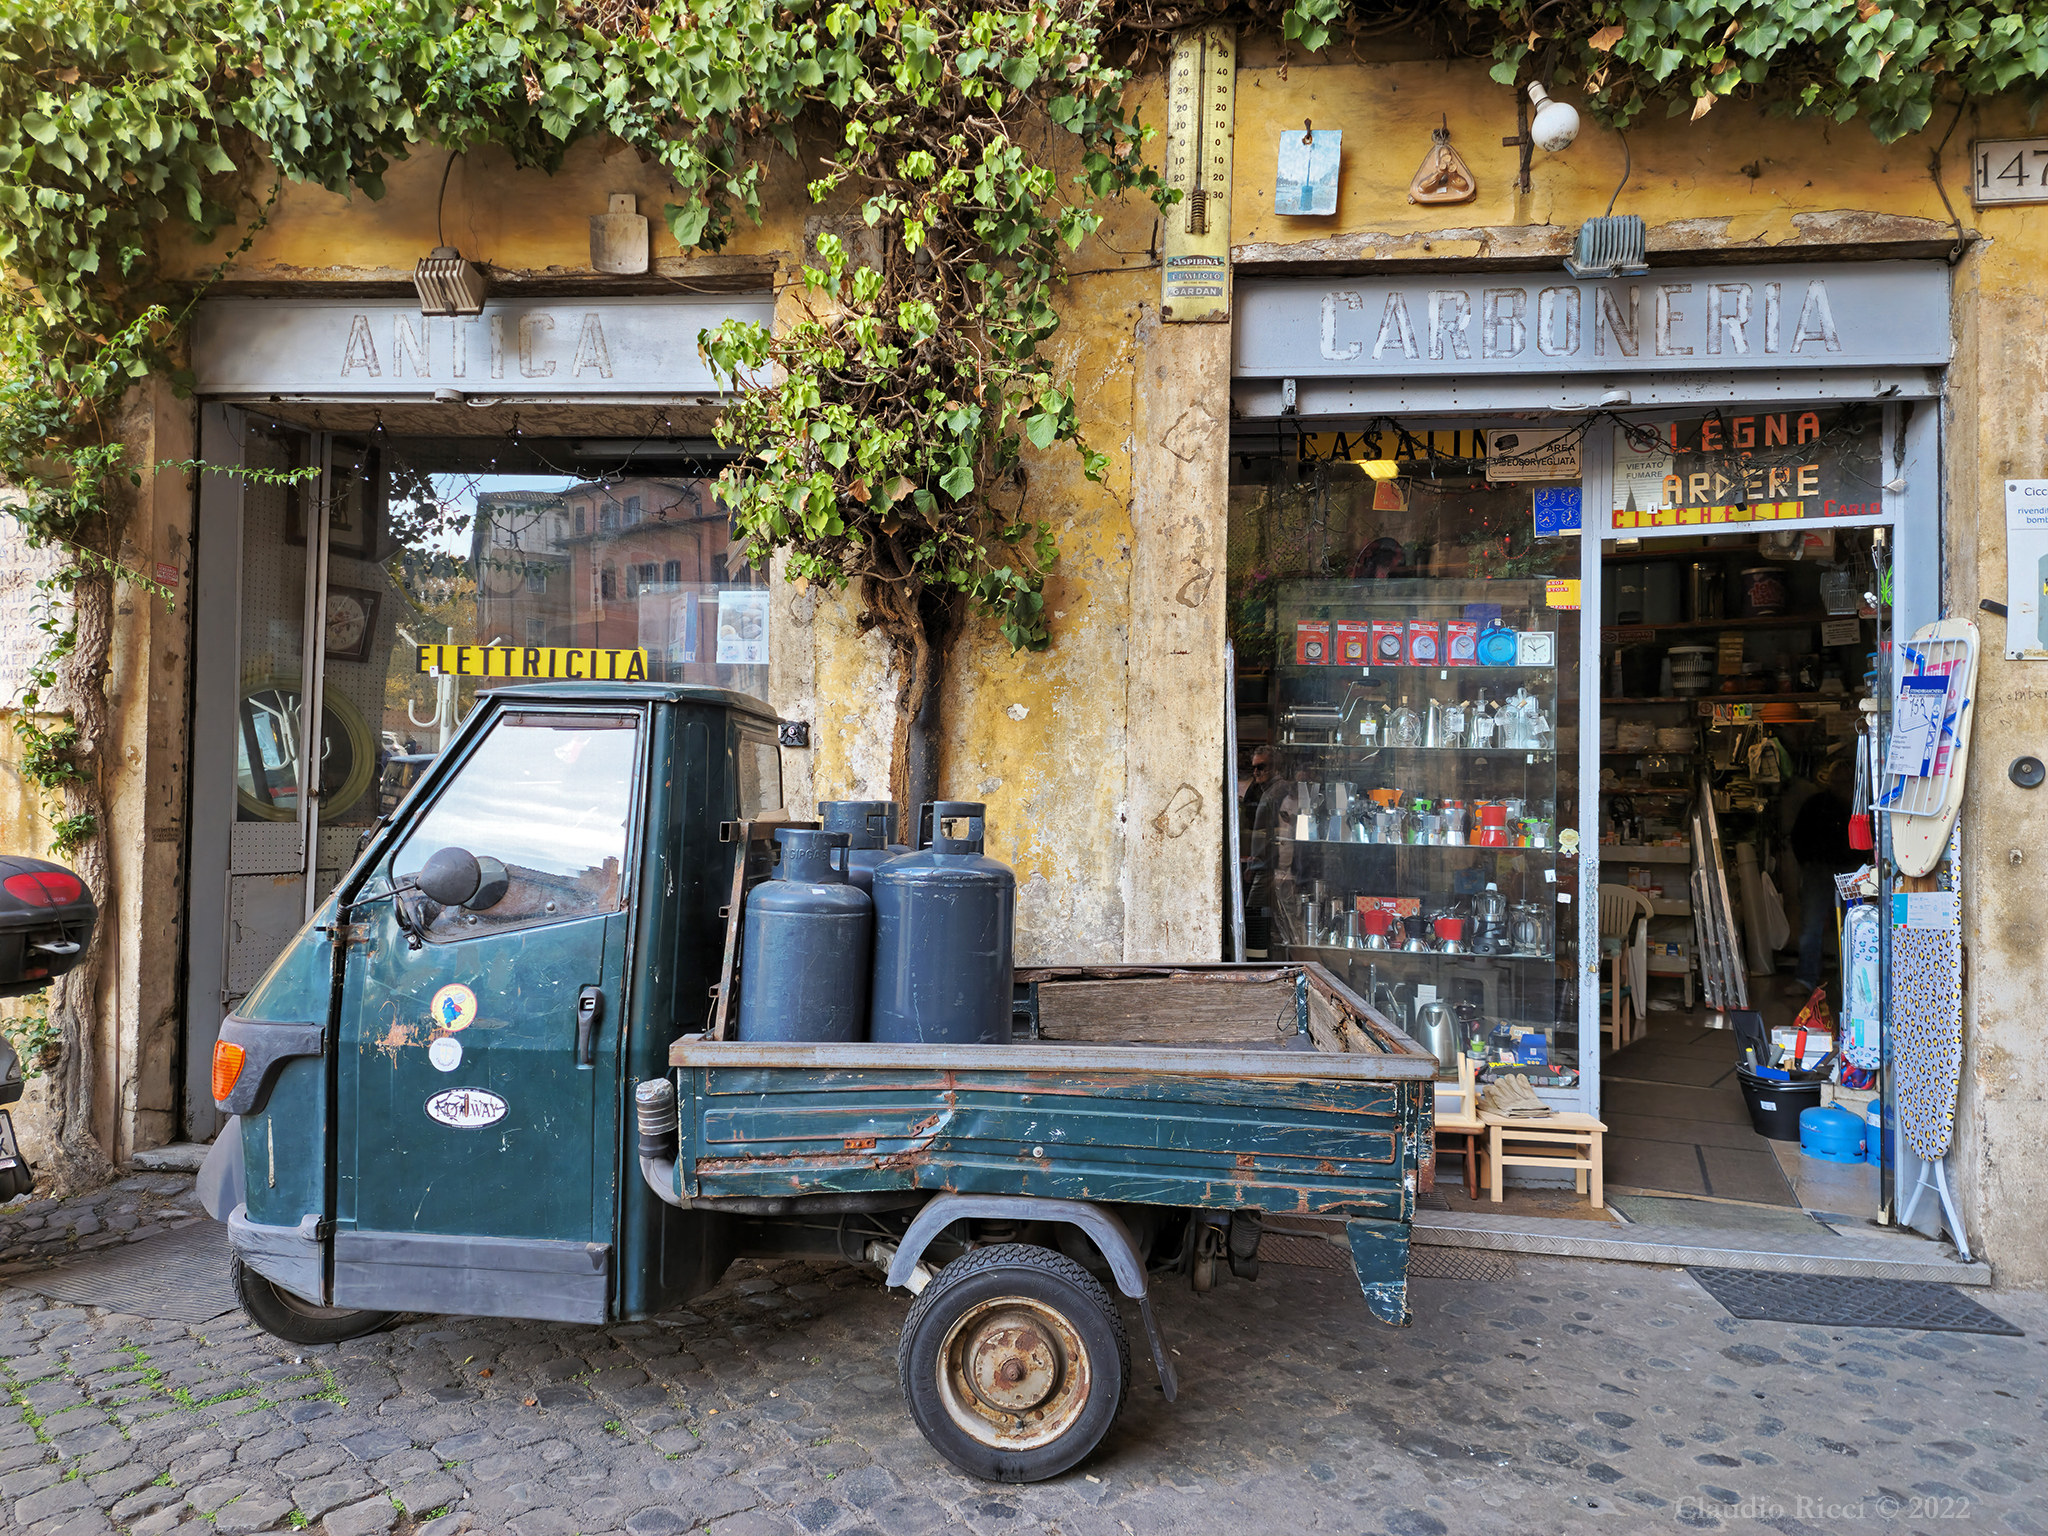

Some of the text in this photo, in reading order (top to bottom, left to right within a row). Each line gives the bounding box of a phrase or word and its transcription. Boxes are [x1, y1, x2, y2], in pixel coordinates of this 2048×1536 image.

[1178, 50, 1229, 59] 50 50
[1178, 67, 1228, 77] 40 40
[1177, 85, 1228, 95] 30 30
[1176, 103, 1227, 113] 20 20
[1176, 120, 1226, 130] 10 10
[1179, 138, 1221, 147] 0 0
[1175, 156, 1225, 165] 10 10
[1174, 173, 1225, 183] 20 20
[1212, 191, 1224, 199] 30
[1173, 258, 1219, 266] ASPIRINA
[1172, 287, 1217, 296] GARDAN
[1318, 280, 1842, 362] CARBONERIA
[340, 313, 613, 379] ANTICA
[1670, 412, 1821, 454] LEGNA
[1546, 443, 1576, 453] AREA
[1626, 461, 1664, 470] VIETATO
[1626, 470, 1663, 480] FUMARE
[1662, 464, 1820, 506] ARDERE
[1613, 501, 1802, 529] CICCHETTI
[415, 645, 646, 682] ELETTRICITA
[784, 848, 828, 860] AGIPGAS
